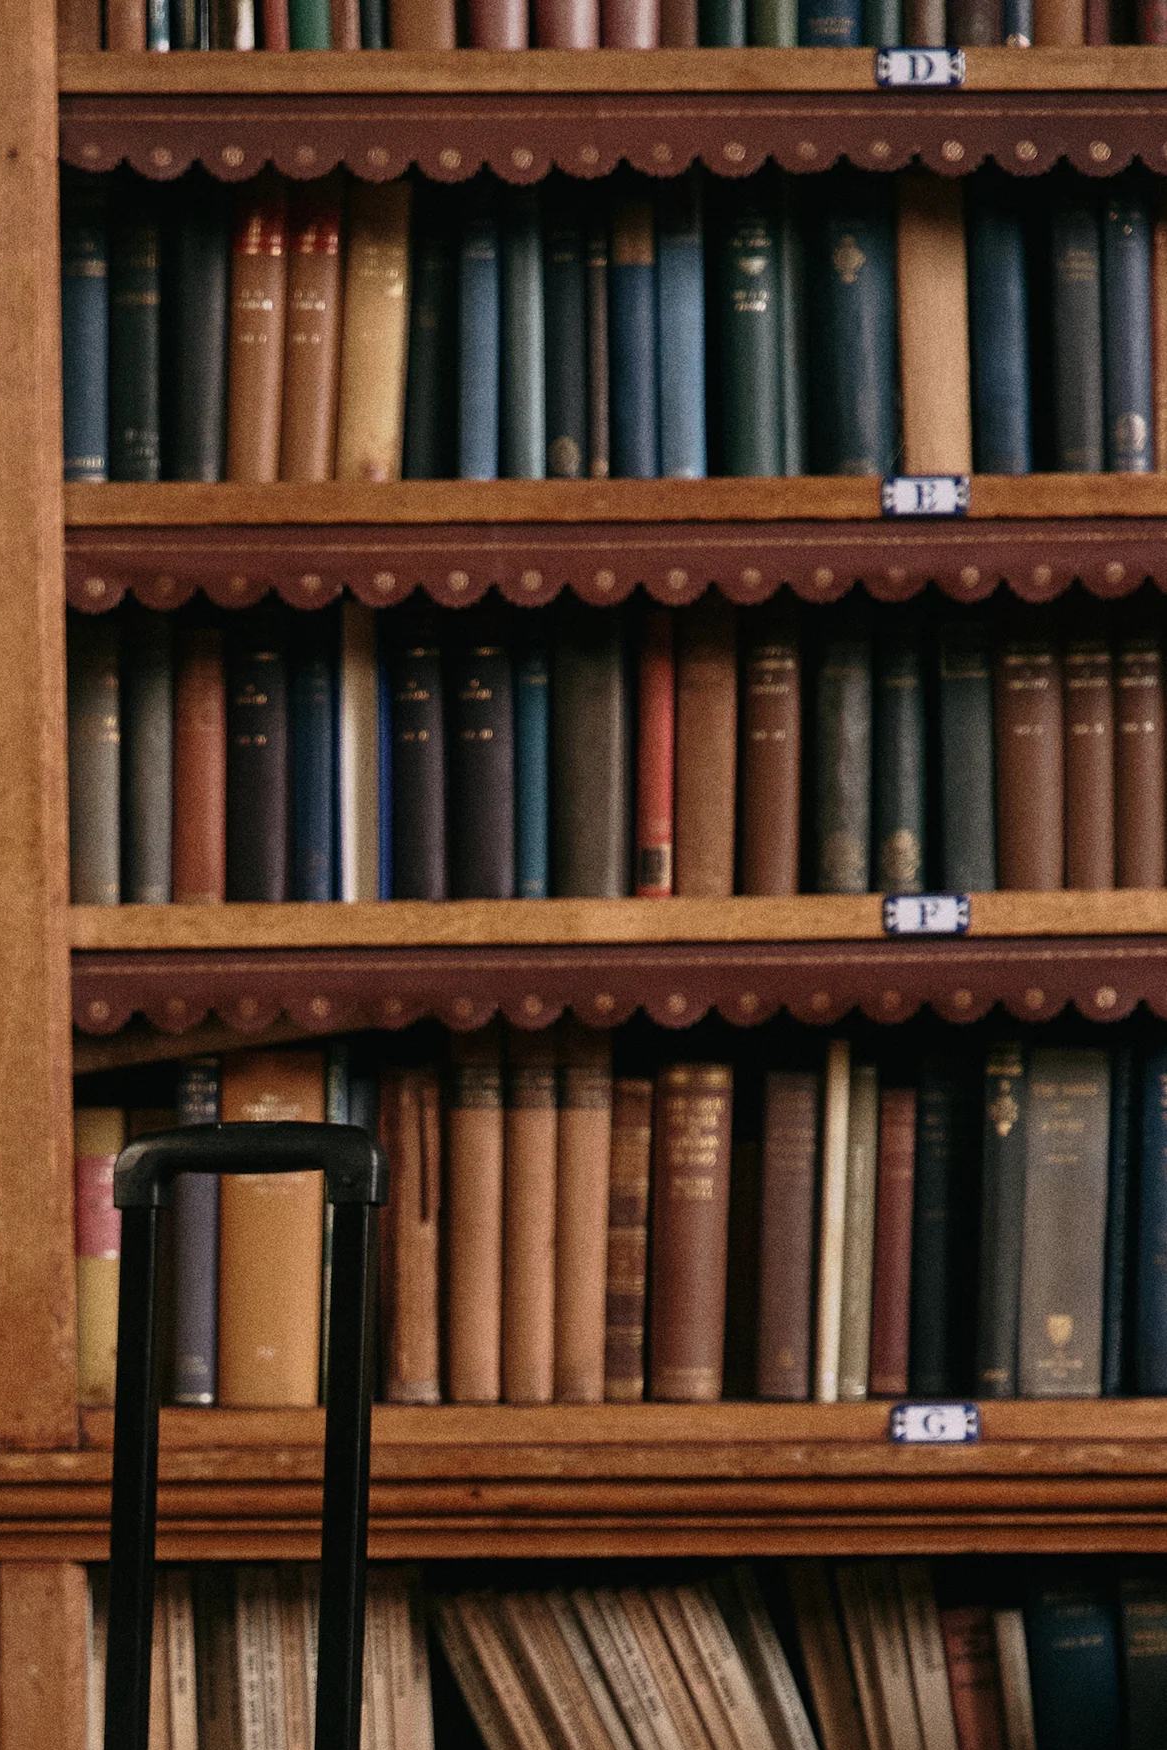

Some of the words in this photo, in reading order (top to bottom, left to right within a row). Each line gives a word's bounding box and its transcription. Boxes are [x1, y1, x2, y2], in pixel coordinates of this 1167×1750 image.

[909, 54, 934, 81] D
[914, 483, 938, 511] E
[923, 1410, 946, 1439] G
